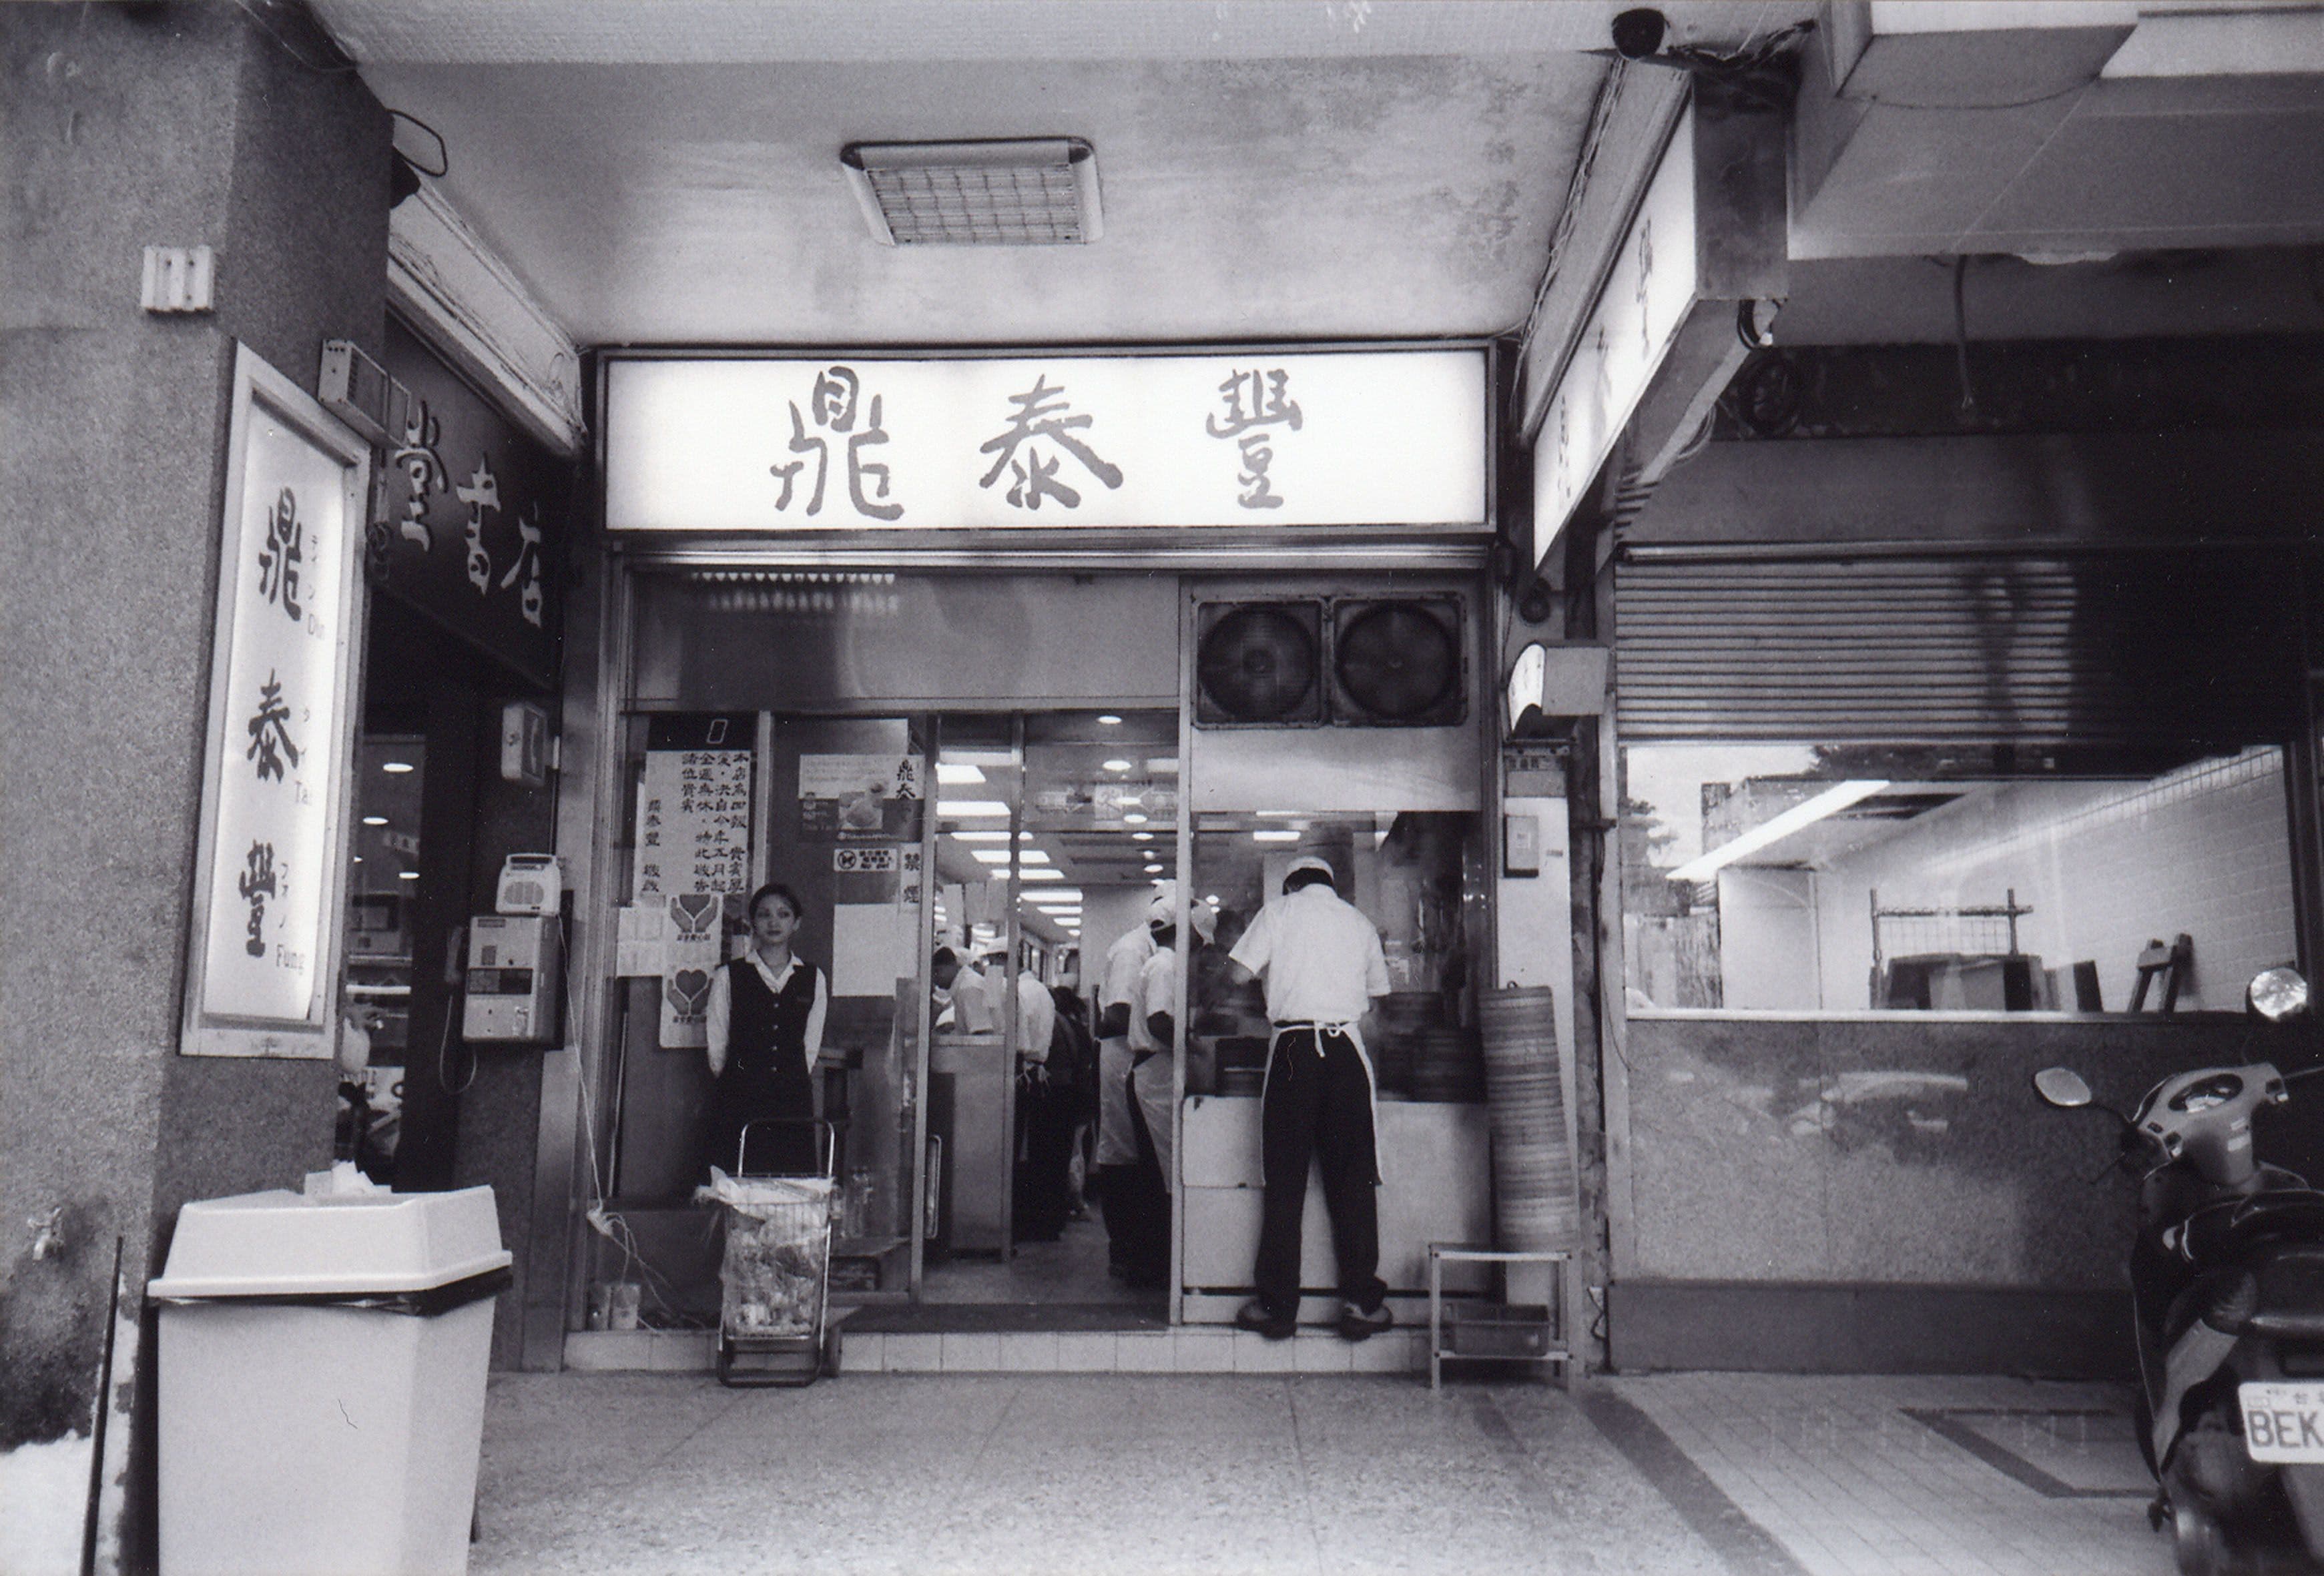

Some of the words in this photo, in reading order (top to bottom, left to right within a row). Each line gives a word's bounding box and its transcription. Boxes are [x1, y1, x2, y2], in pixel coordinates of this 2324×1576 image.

[770, 366, 1303, 521] 鼎泰豐
[239, 486, 302, 958] 鼎泰豐
[2247, 1409, 2324, 1449] BEK
